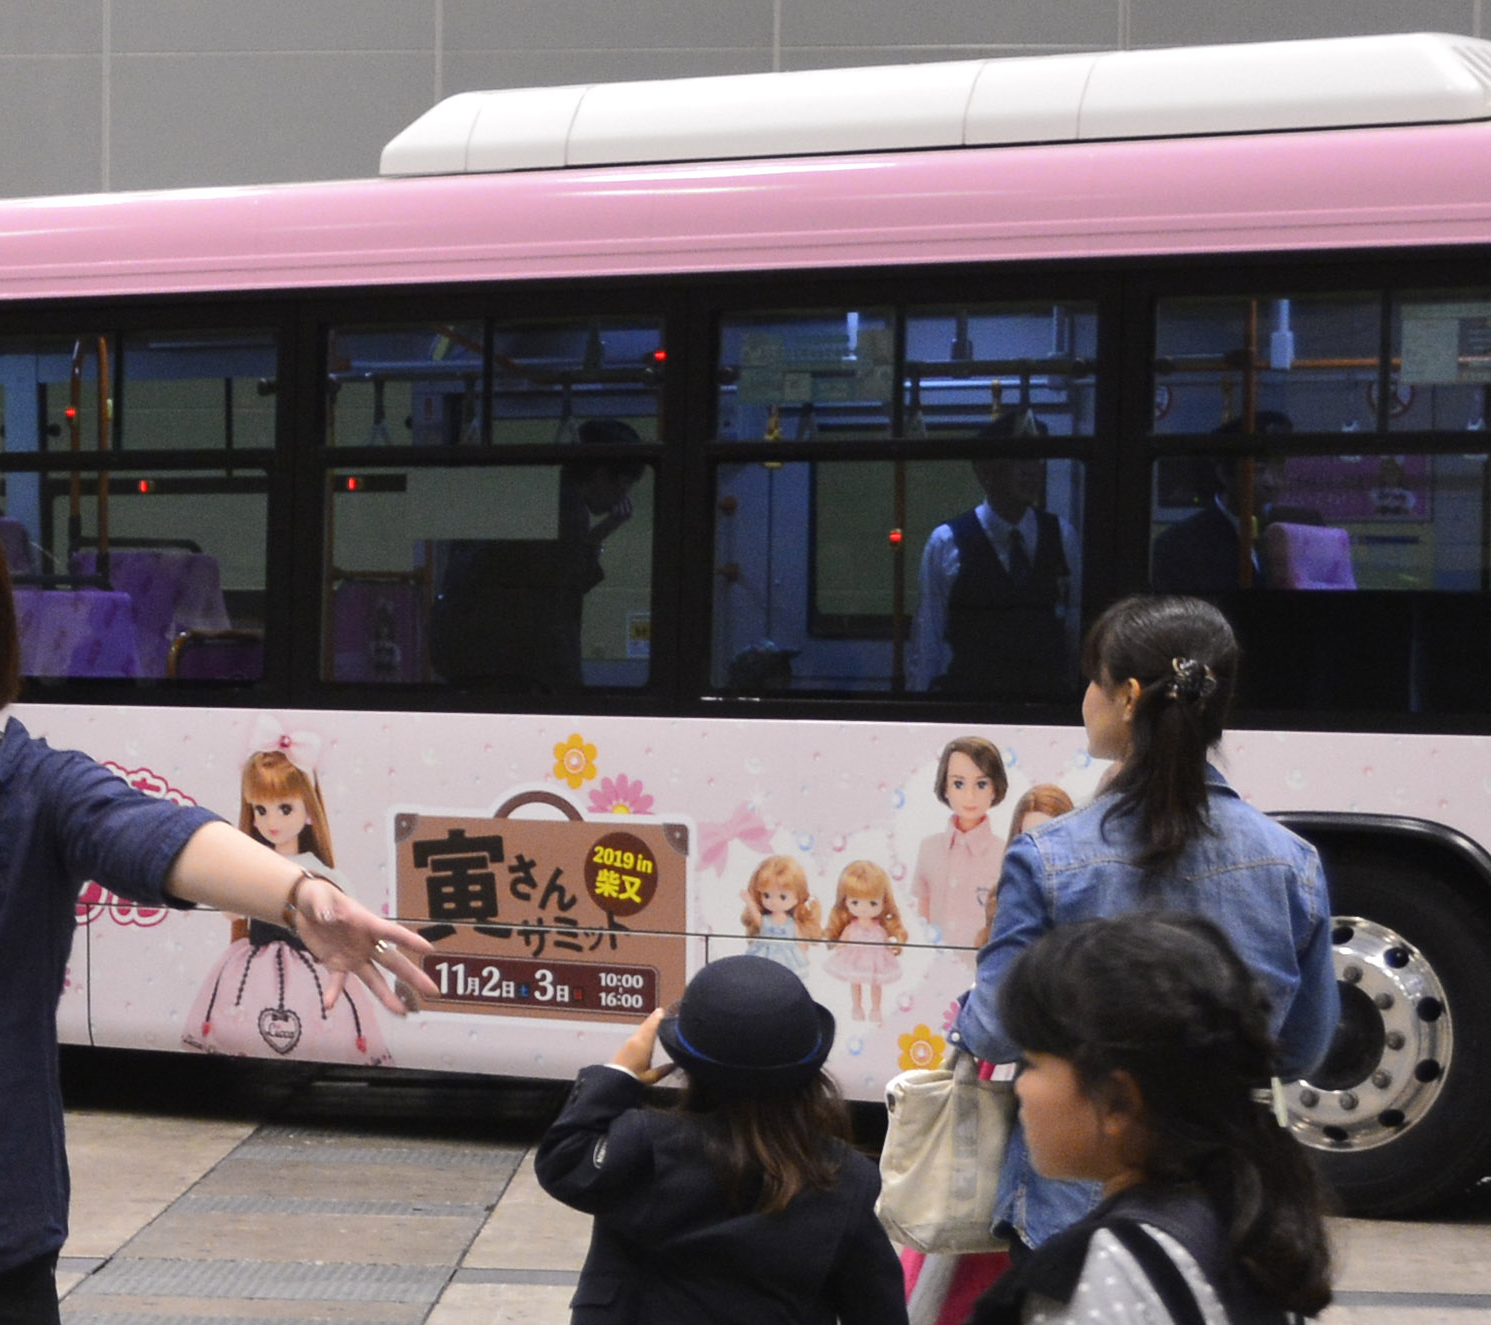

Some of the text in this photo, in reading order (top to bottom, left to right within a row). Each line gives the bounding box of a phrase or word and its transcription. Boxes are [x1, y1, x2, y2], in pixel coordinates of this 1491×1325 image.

[592, 846, 653, 874] 2019 in
[594, 868, 642, 904] 柴又
[518, 911, 631, 958] サミット
[598, 972, 644, 989] 10:00
[599, 991, 644, 1009] 16:00
